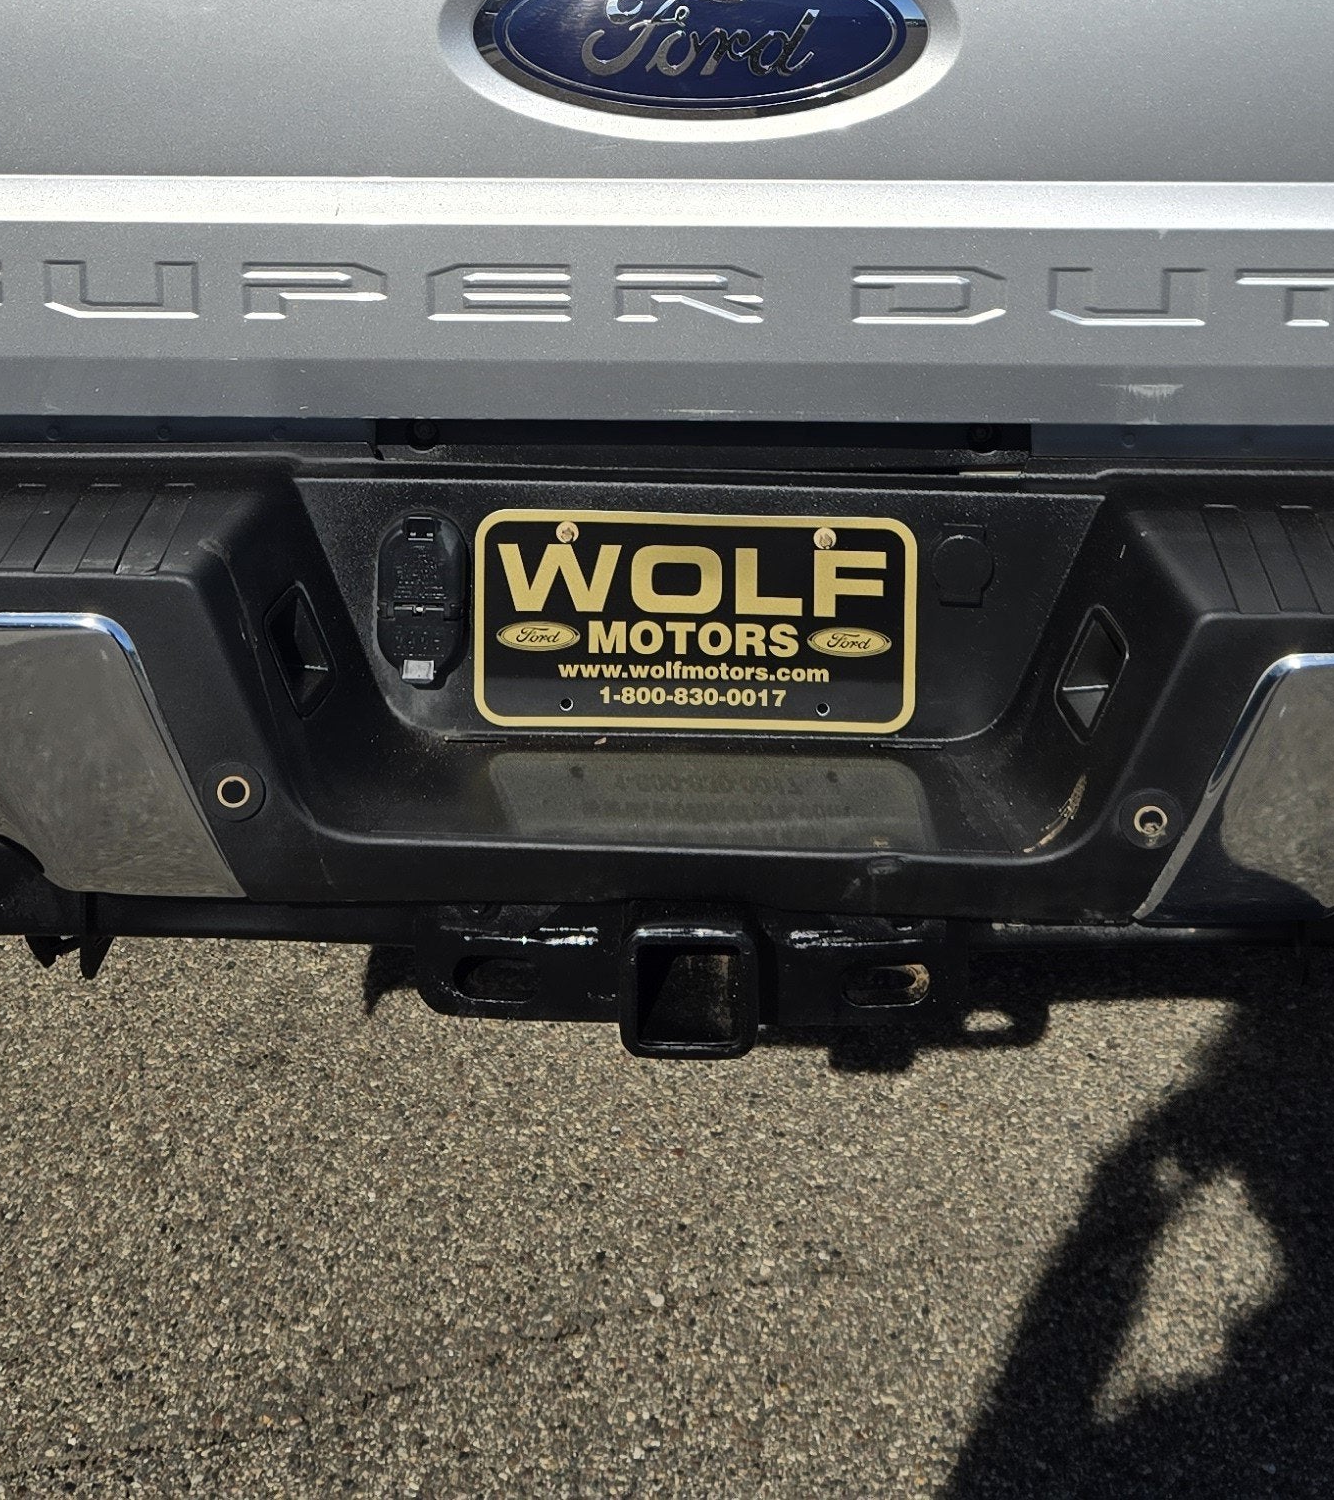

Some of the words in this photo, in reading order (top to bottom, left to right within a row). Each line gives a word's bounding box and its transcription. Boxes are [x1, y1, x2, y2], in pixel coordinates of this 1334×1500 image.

[497, 543, 887, 618] WOLF
[515, 626, 562, 645] Ford
[588, 620, 799, 657] MOTORS
[827, 632, 873, 650] Ford
[558, 659, 830, 683] www.wolfmotors.com
[599, 686, 787, 708] 1-800-830-0017
